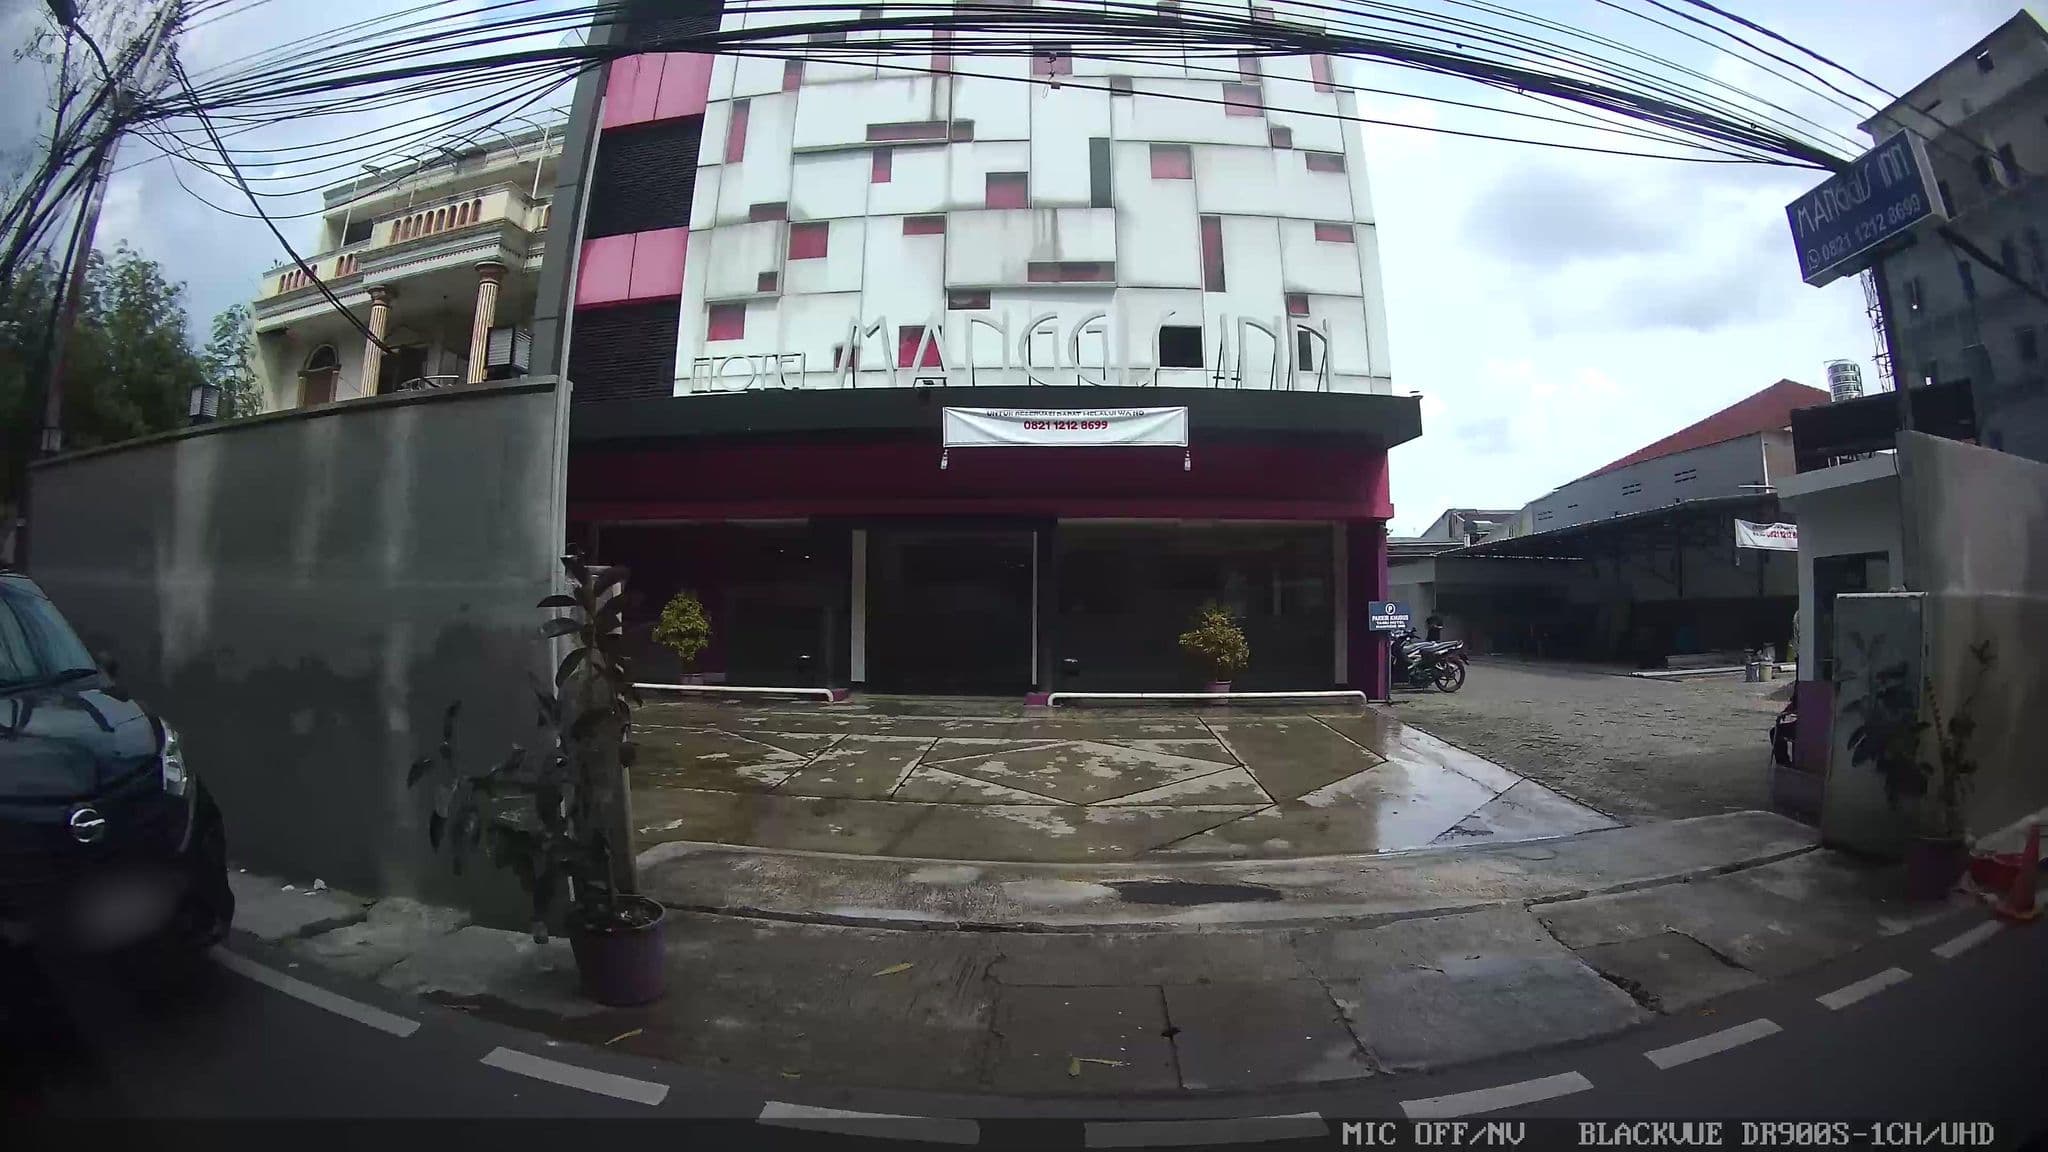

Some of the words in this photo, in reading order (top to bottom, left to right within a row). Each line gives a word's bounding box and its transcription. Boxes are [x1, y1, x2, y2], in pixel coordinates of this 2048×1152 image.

[1821, 234, 1851, 260] 0821
[1855, 213, 1887, 242] 1212
[1887, 193, 1921, 225] 8699
[689, 352, 806, 393] HOTEL
[1023, 420, 1050, 430] 0821
[1053, 420, 1078, 430] 1212
[1080, 420, 1109, 430] 8699
